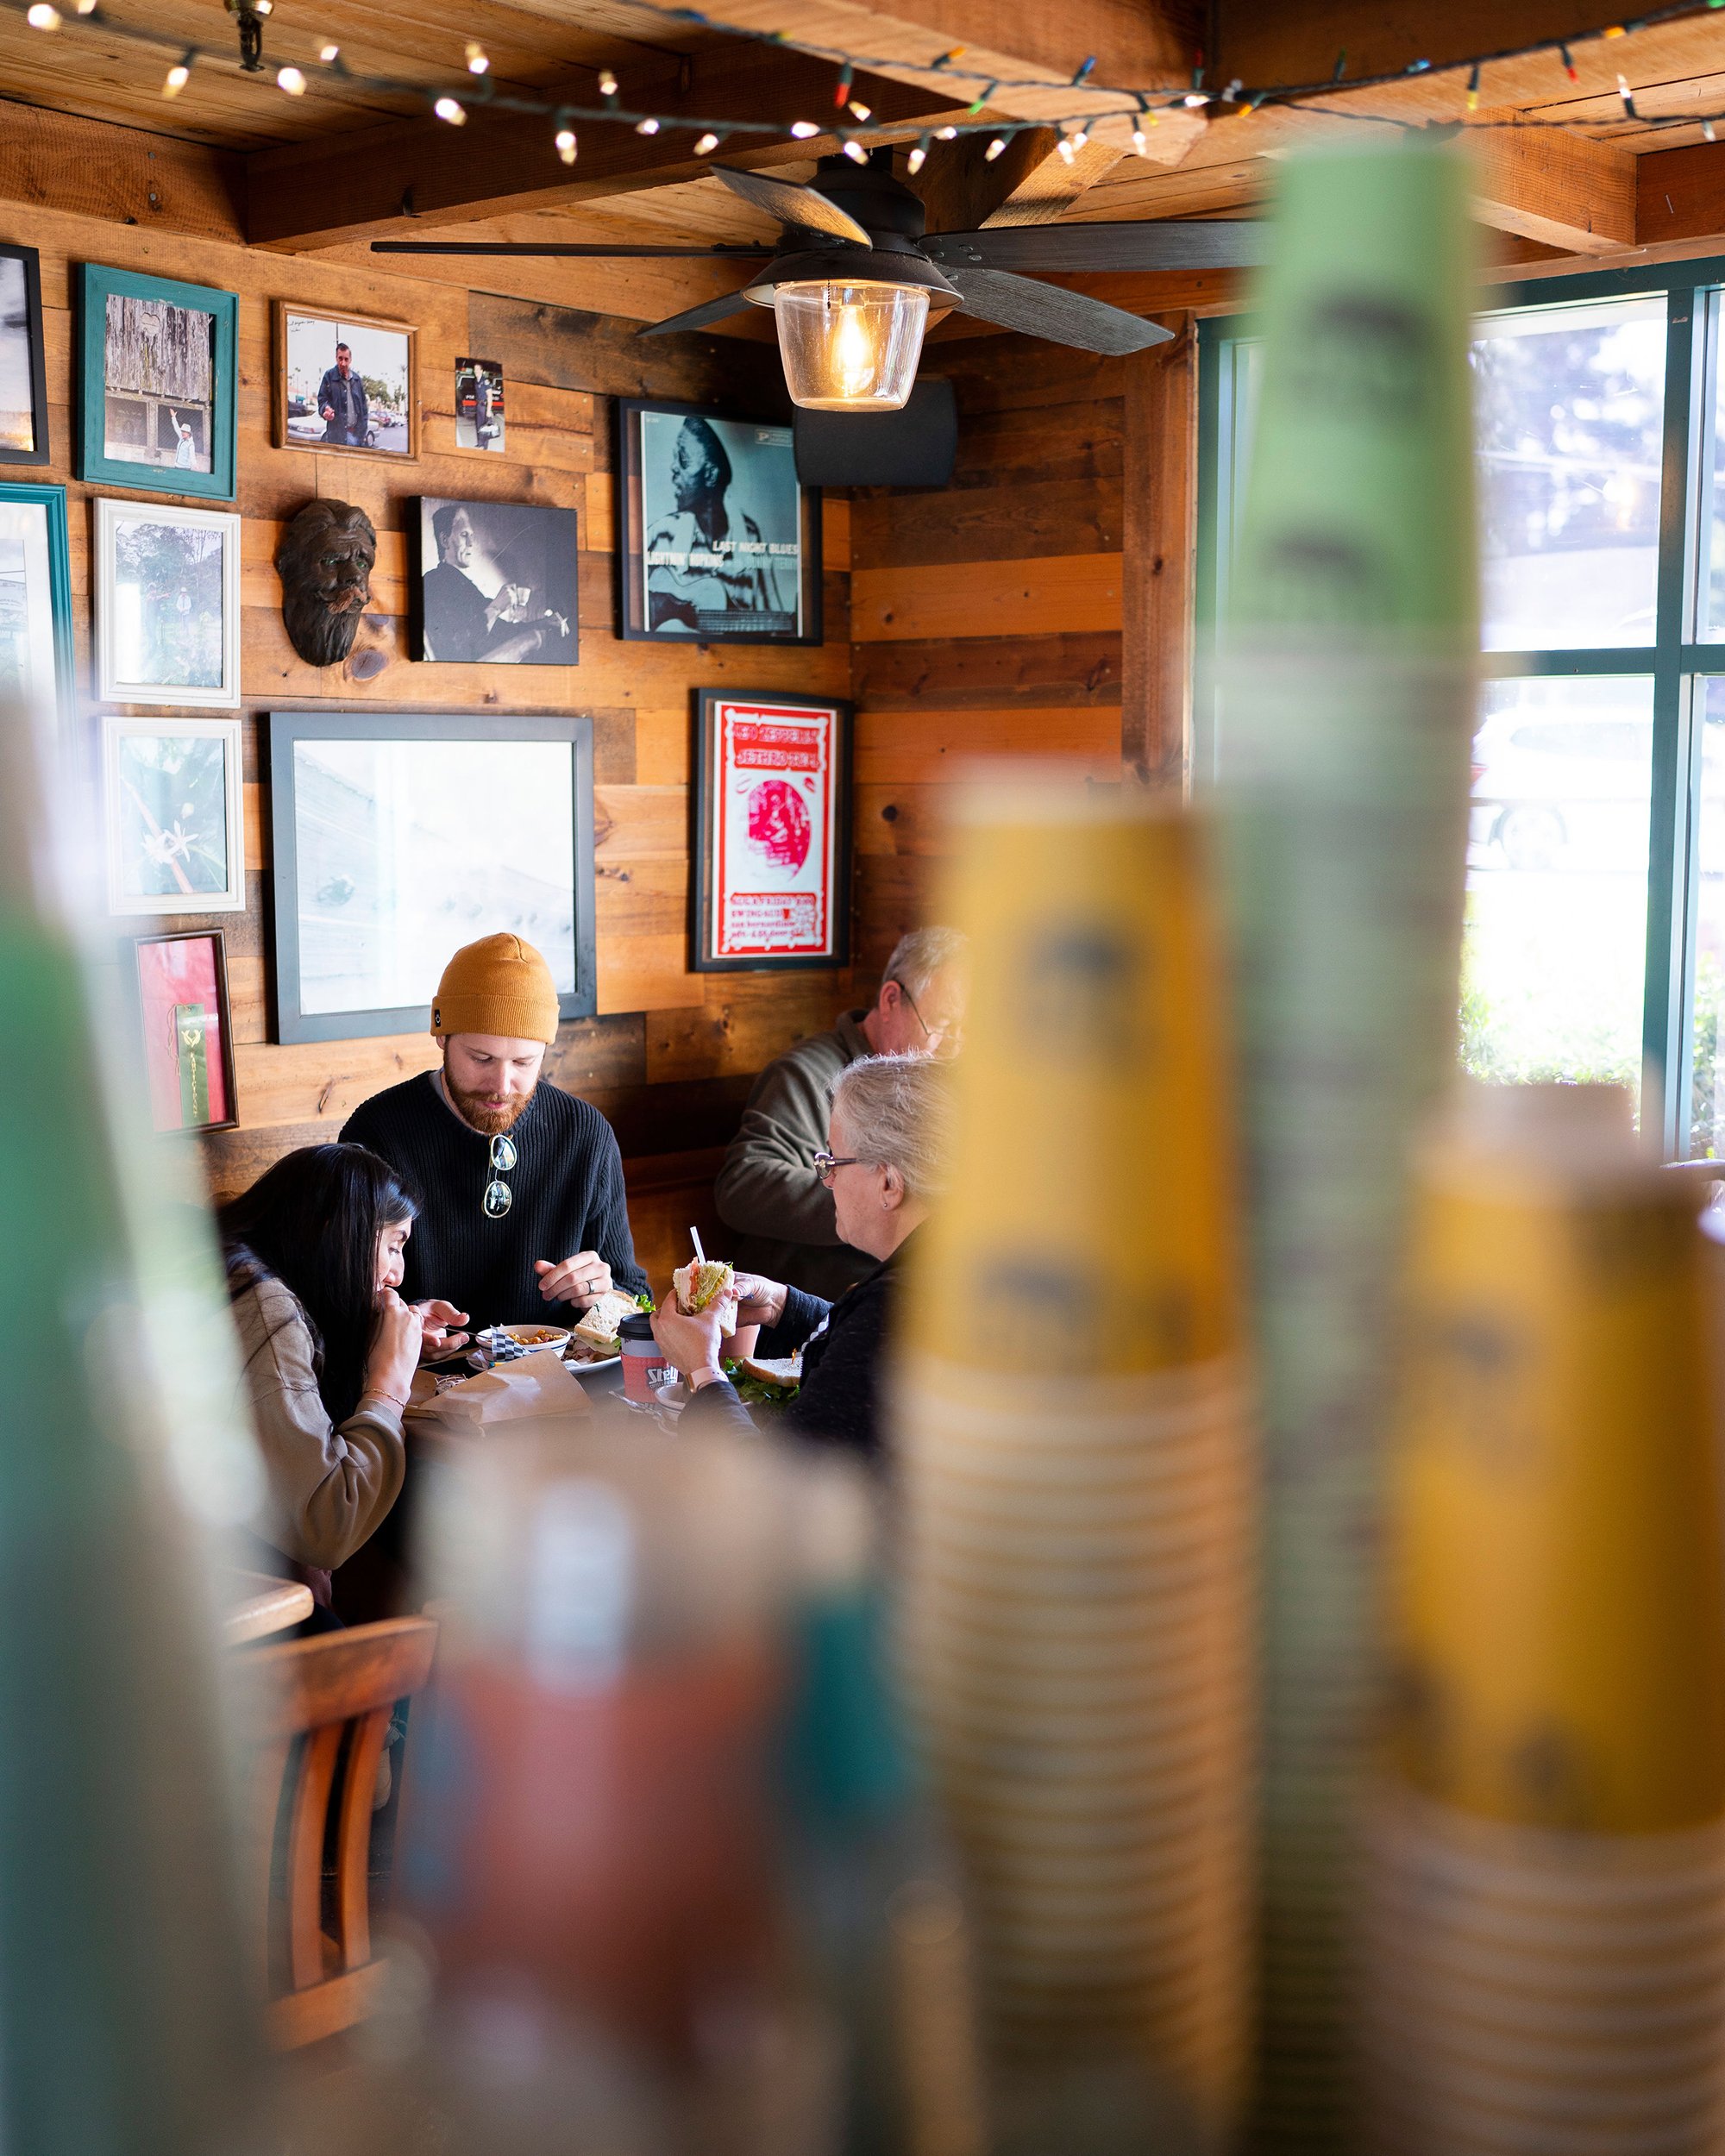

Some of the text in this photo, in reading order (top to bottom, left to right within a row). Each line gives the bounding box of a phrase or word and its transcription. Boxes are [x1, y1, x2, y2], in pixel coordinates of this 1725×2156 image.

[712, 540, 798, 555] LAST NIGHT BLUES
[736, 749, 787, 767] JETHRO
